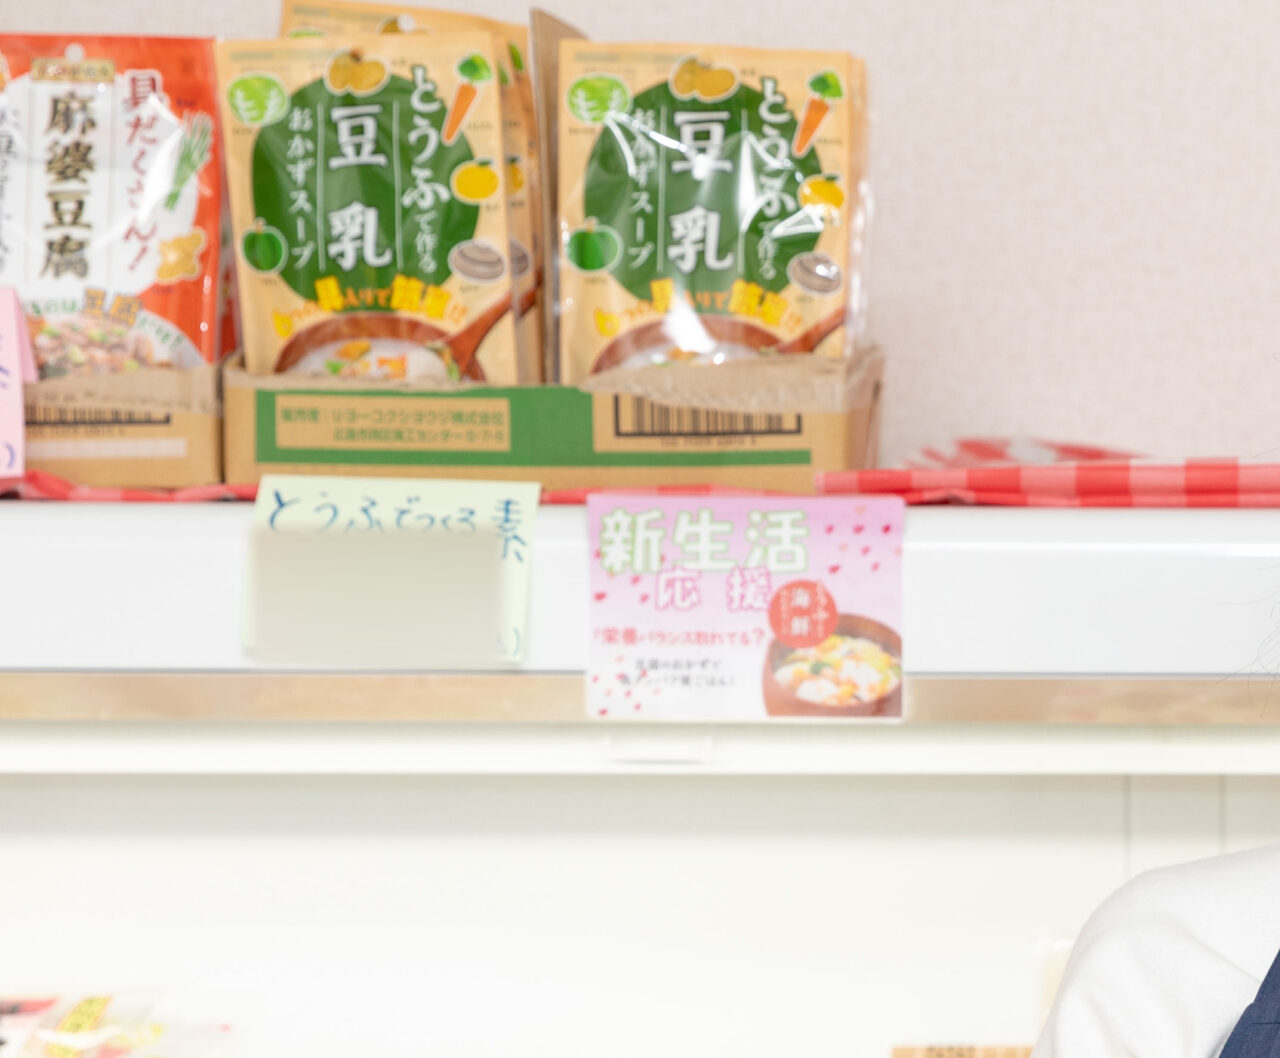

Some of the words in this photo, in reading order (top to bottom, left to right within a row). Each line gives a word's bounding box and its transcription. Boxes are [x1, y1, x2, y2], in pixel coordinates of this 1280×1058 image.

[40, 90, 98, 280] 麻婆豆腐
[287, 107, 316, 269] おかずスープ
[327, 105, 394, 271] 豆乳
[402, 64, 451, 273] とうふで作る
[667, 111, 735, 274] 豆乳
[599, 506, 810, 575] 新生活
[654, 565, 773, 614] 応援
